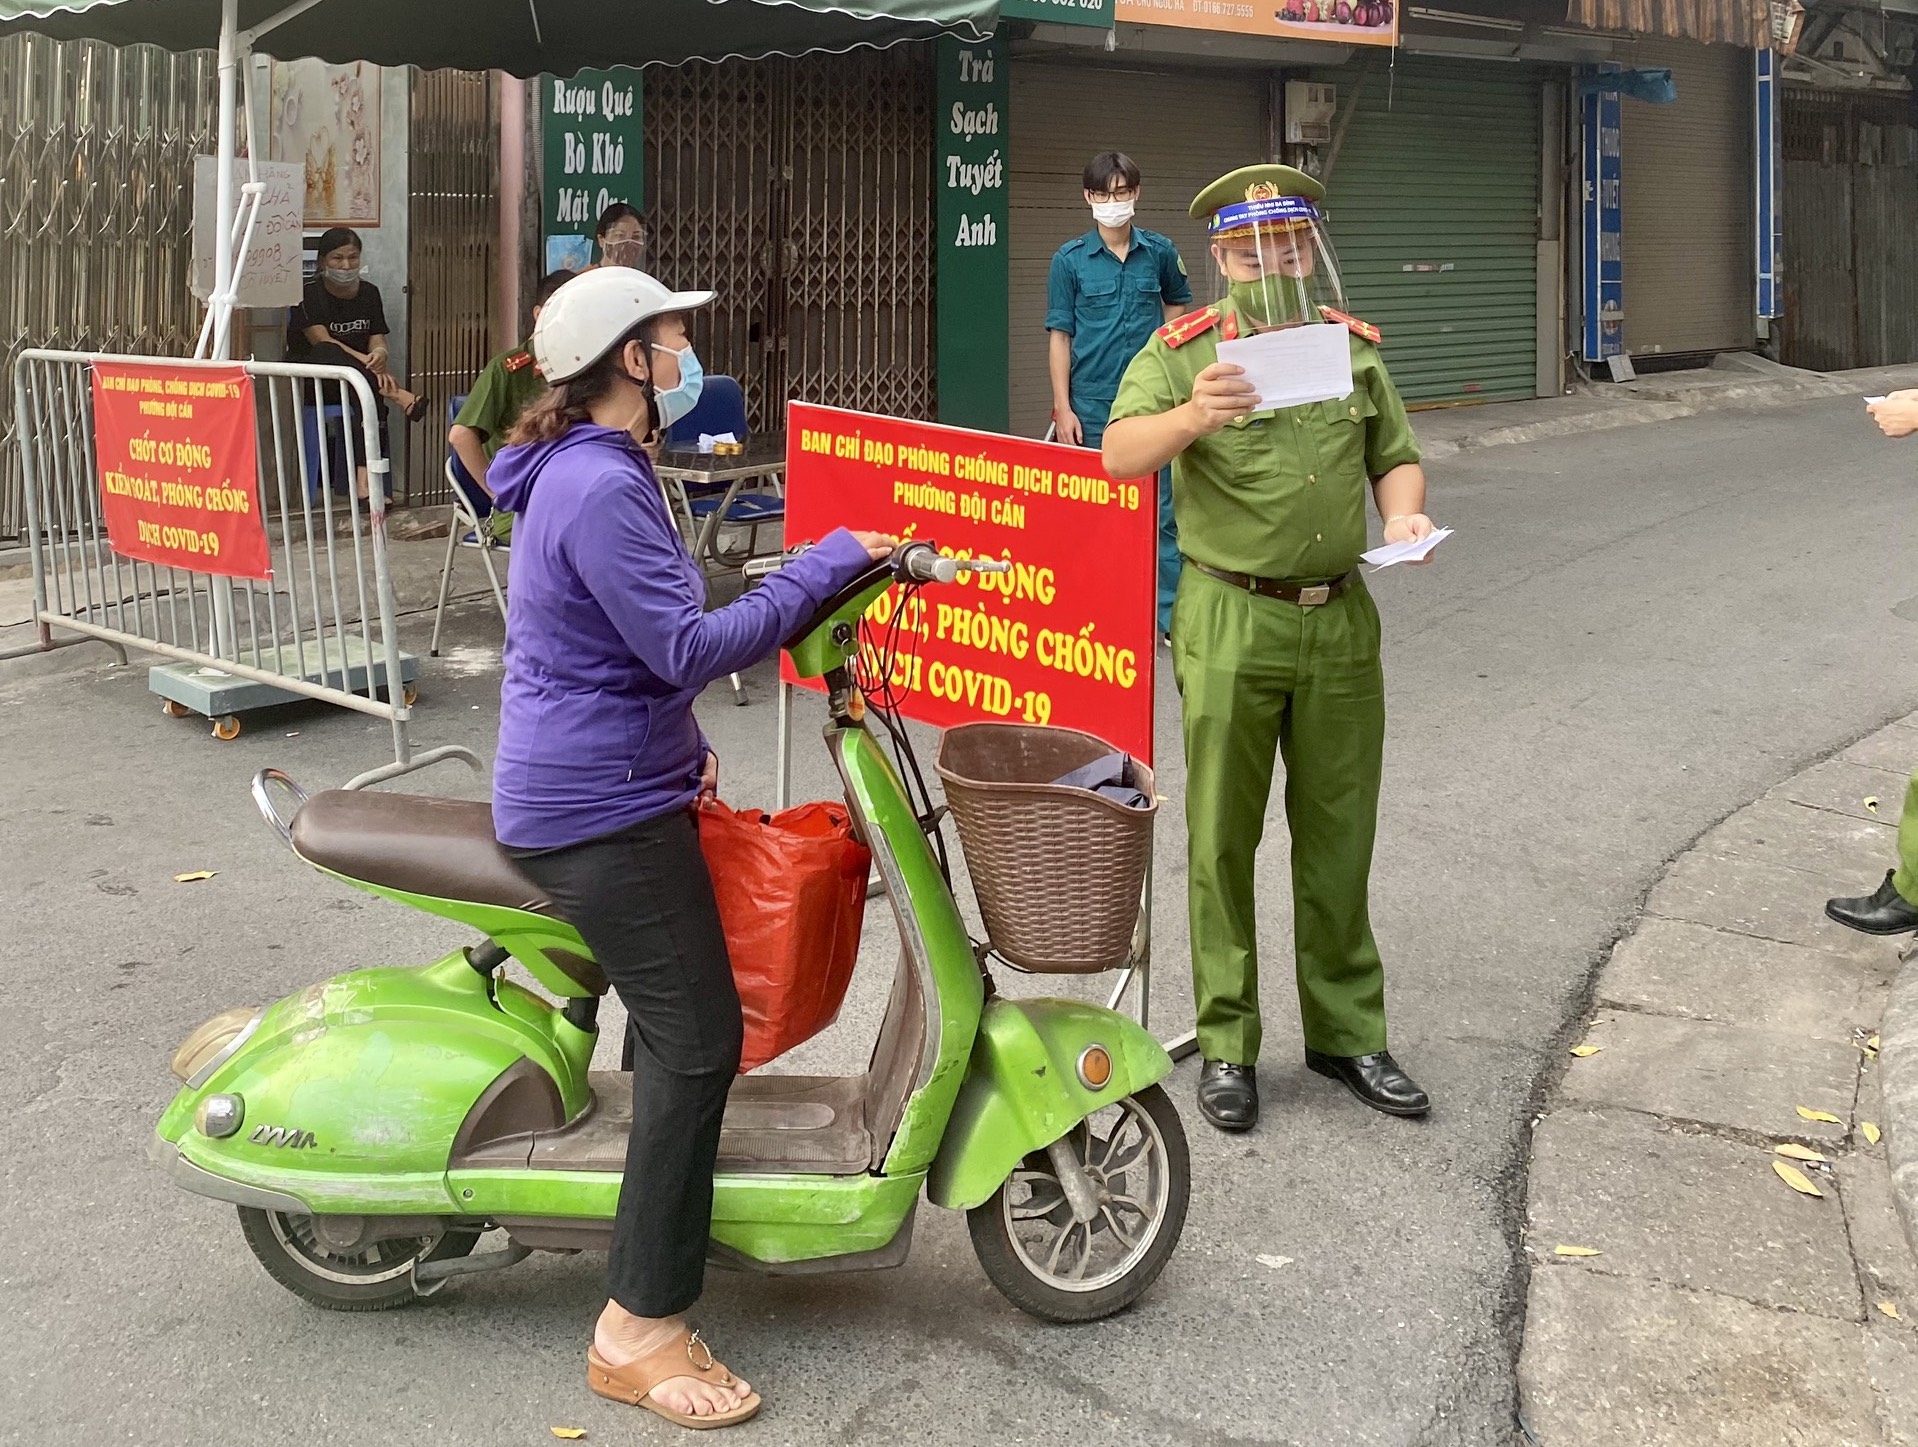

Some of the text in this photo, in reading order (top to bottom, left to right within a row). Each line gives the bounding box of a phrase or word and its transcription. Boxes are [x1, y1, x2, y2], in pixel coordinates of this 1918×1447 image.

[958, 49, 994, 82] Trà
[553, 80, 634, 122] Rượu Quê
[951, 101, 998, 142] Sạch
[563, 131, 624, 175] Bò Khô
[946, 149, 1003, 195] Tuyết
[556, 187, 589, 231] Mật
[954, 213, 997, 246] Anh
[129, 429, 212, 473] CHỐT CƠ ĐỘNG
[801, 429, 1141, 511] BAN CHỈ ĐẠO PHÒNG CHỐNG DỊCH COVID-19
[160, 477, 203, 510] PHÒNG
[205, 478, 250, 514] CHỐNG
[893, 481, 1026, 530] PHƯỜNG ĐỘI CẤN
[138, 519, 220, 557] DỊCH COVID-19
[977, 547, 1057, 606] ĐỘNG
[864, 582, 1137, 689] OÁT, PHÒNG CHỐNG
[927, 660, 1052, 727] COVID-19
